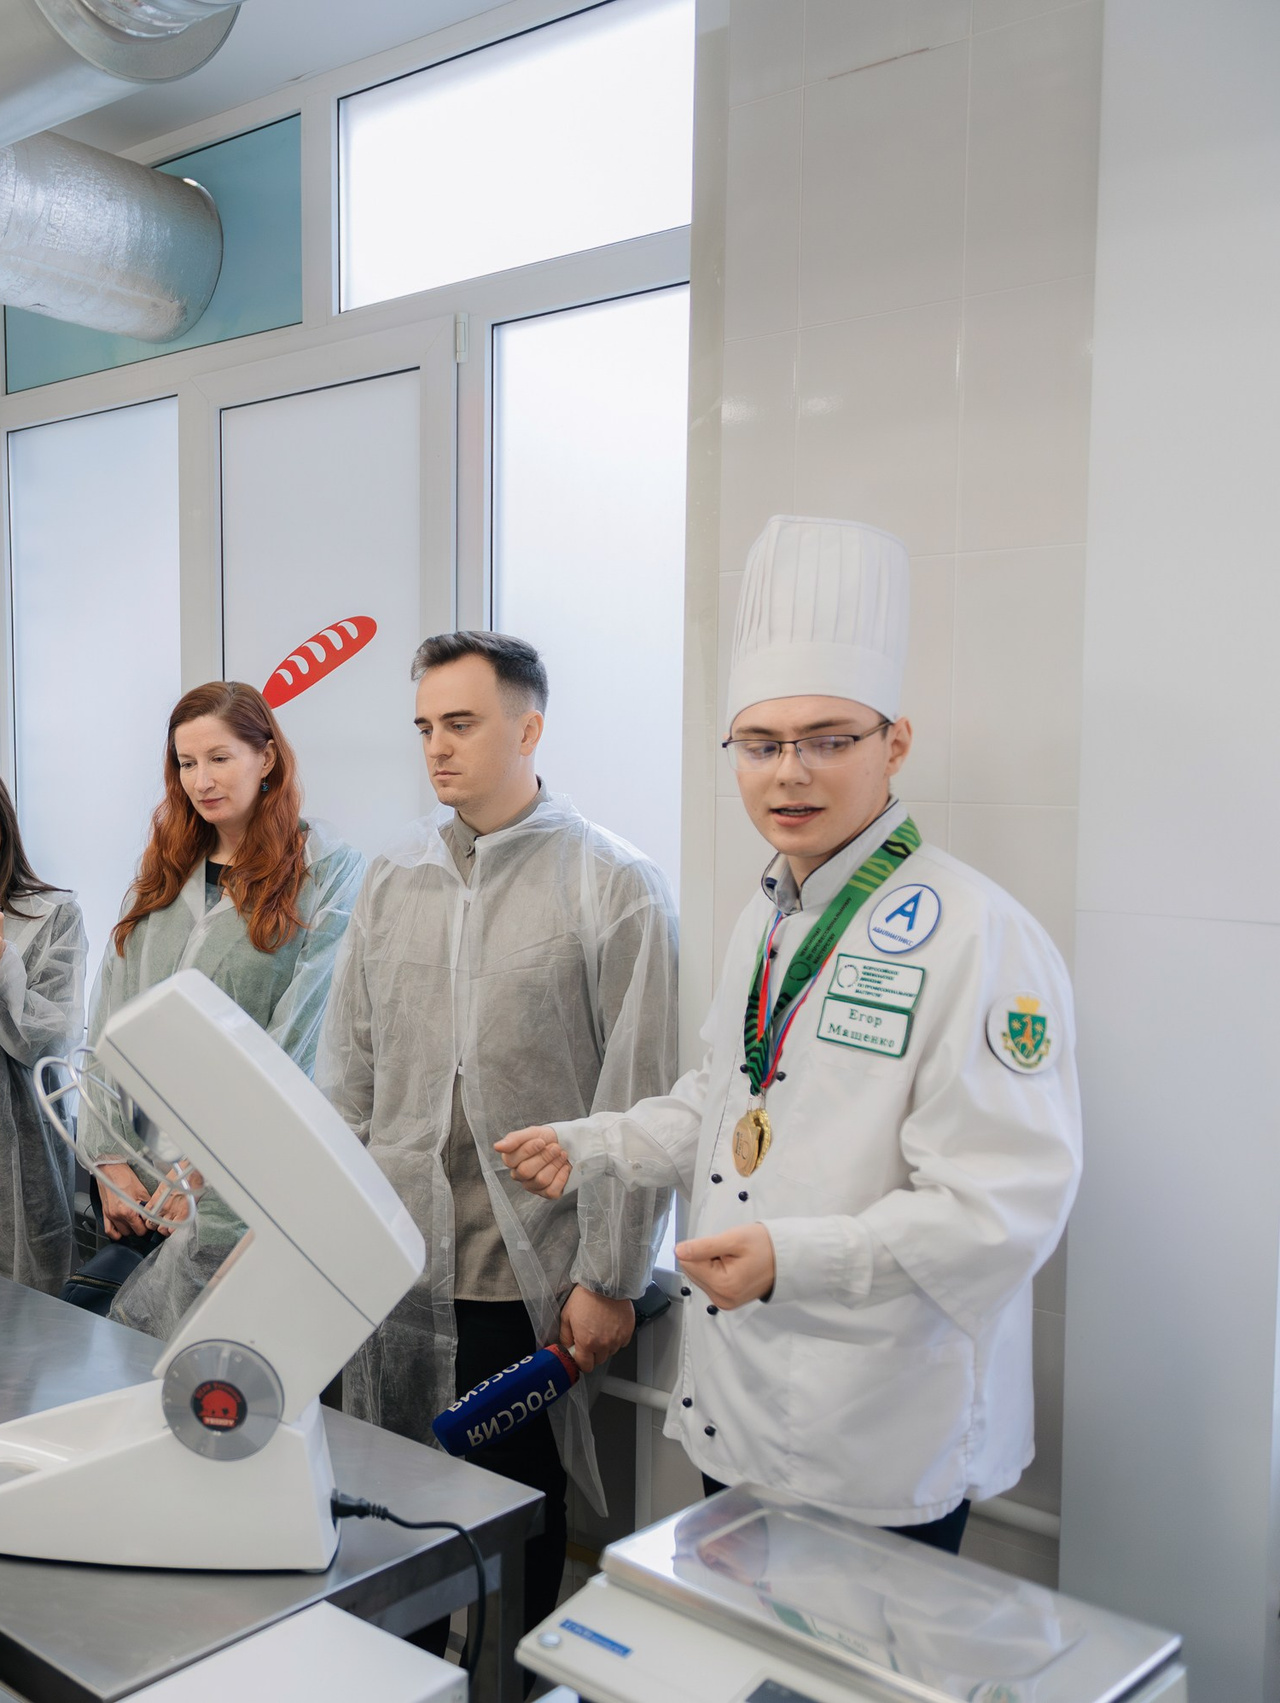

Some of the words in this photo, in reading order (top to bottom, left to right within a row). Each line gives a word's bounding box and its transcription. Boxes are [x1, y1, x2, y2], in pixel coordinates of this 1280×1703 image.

[799, 927, 822, 956] ЧЕМПИОНАТ
[848, 1008, 883, 1028] Егор
[466, 1379, 558, 1448] РОССИЯ
